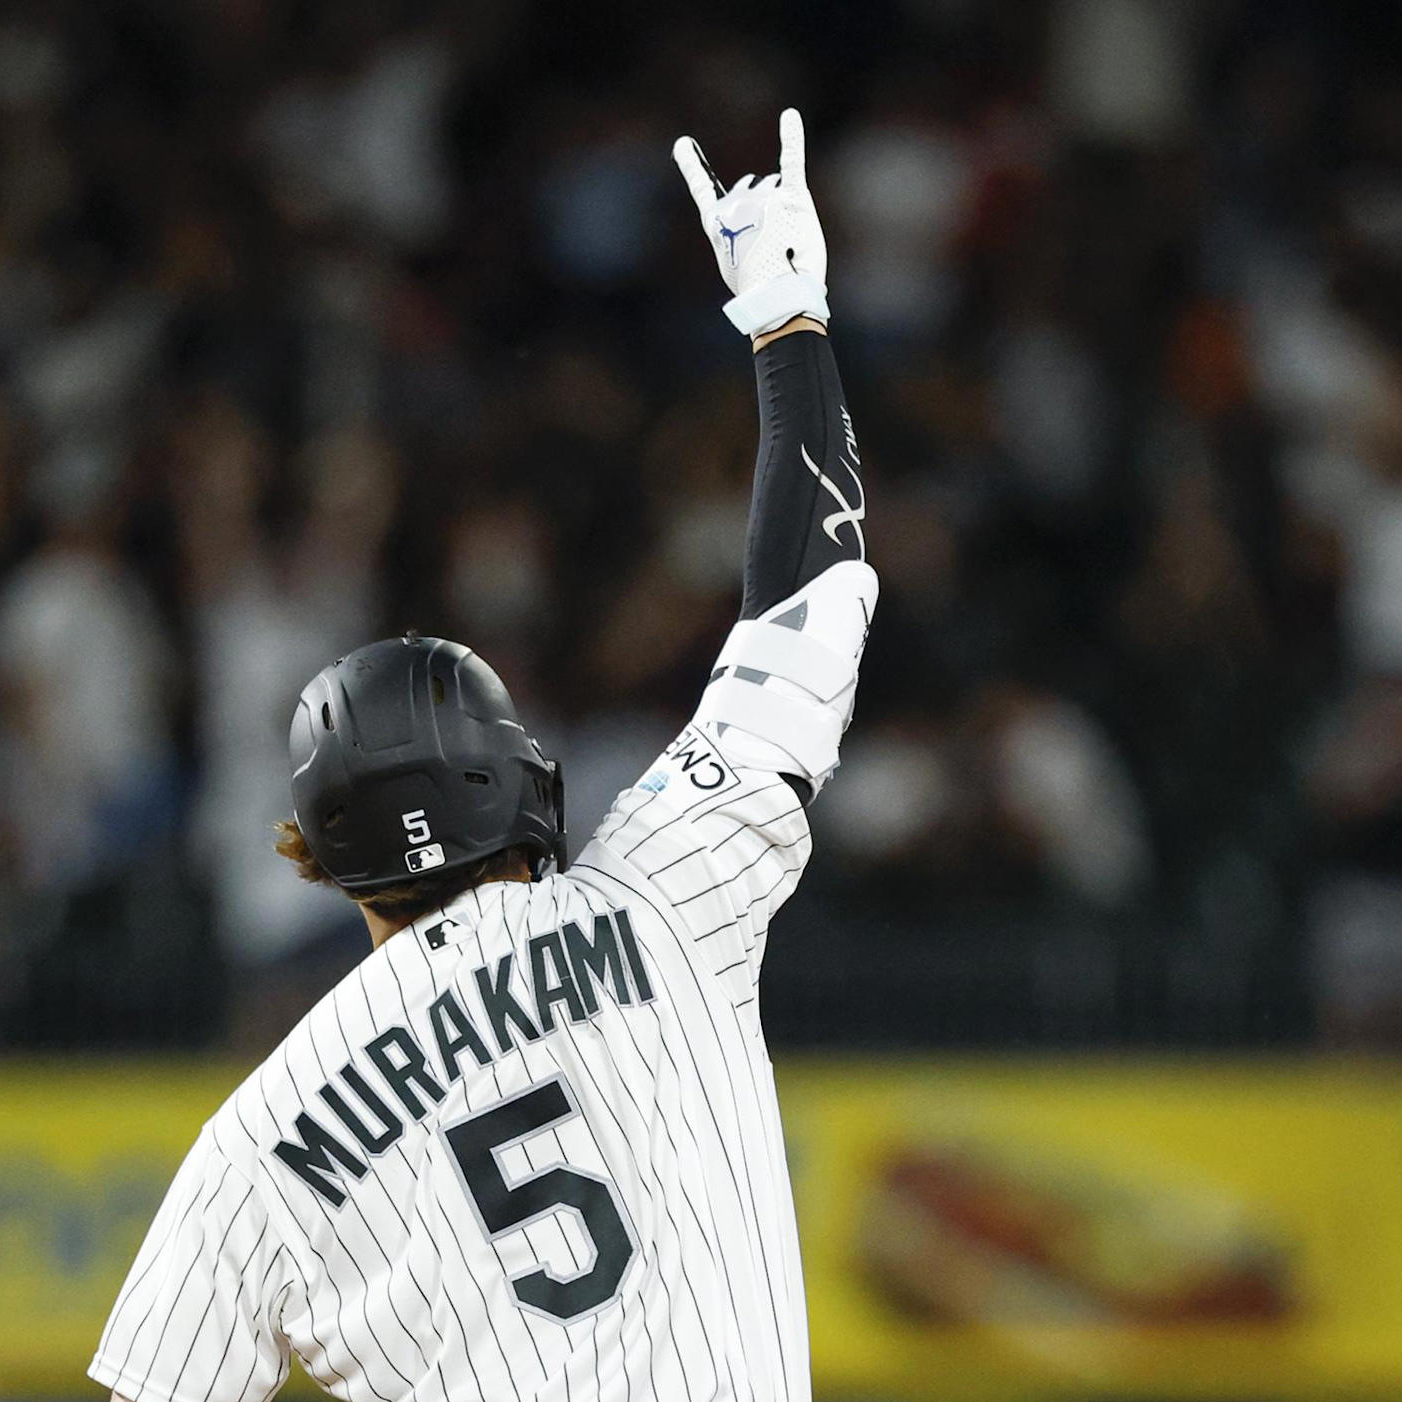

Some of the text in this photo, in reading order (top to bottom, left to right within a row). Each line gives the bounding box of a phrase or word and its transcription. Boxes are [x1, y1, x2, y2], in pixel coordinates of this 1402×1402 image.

[401, 808, 432, 845] 5
[271, 905, 658, 1214] MURAKAMI
[437, 1072, 640, 1326] 5
